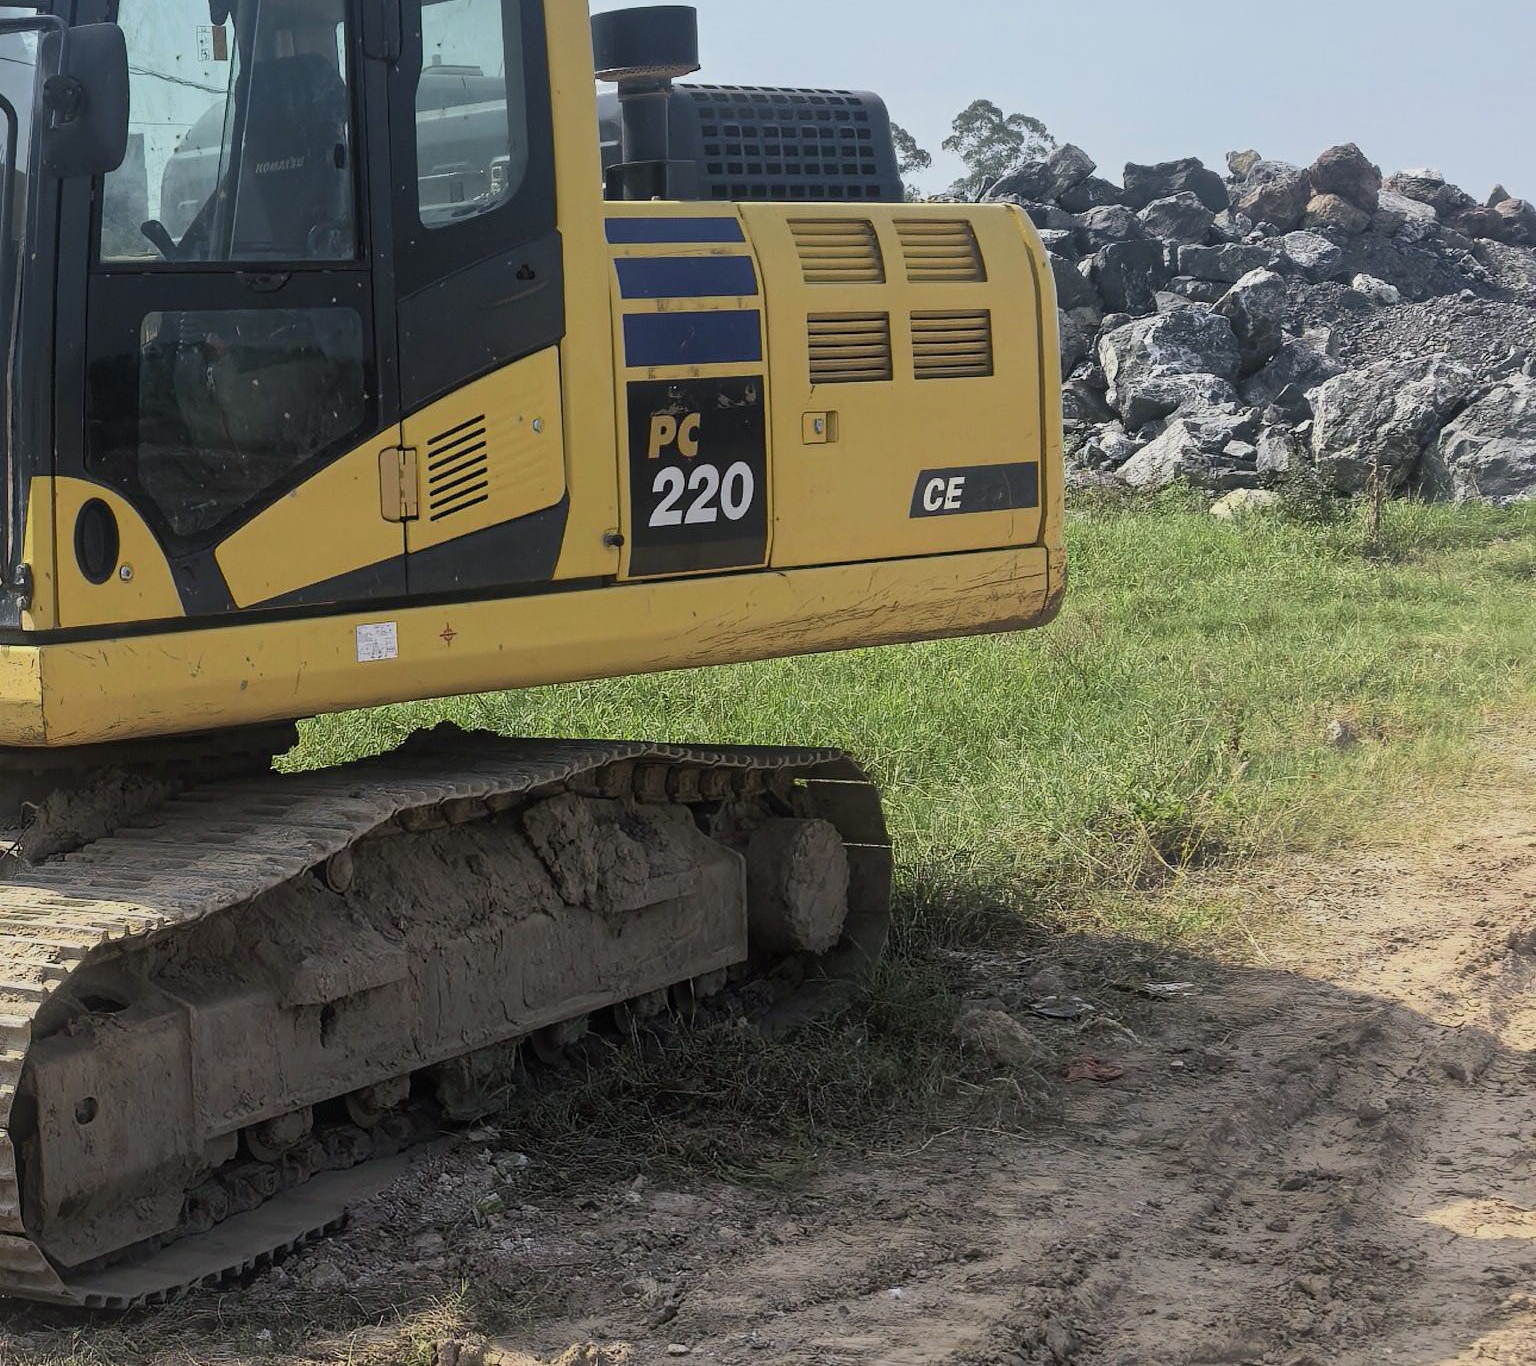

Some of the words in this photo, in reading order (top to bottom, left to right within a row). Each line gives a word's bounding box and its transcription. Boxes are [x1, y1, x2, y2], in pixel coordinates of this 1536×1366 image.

[647, 412, 701, 459] PC
[648, 460, 755, 527] 220
[923, 476, 966, 512] CE
